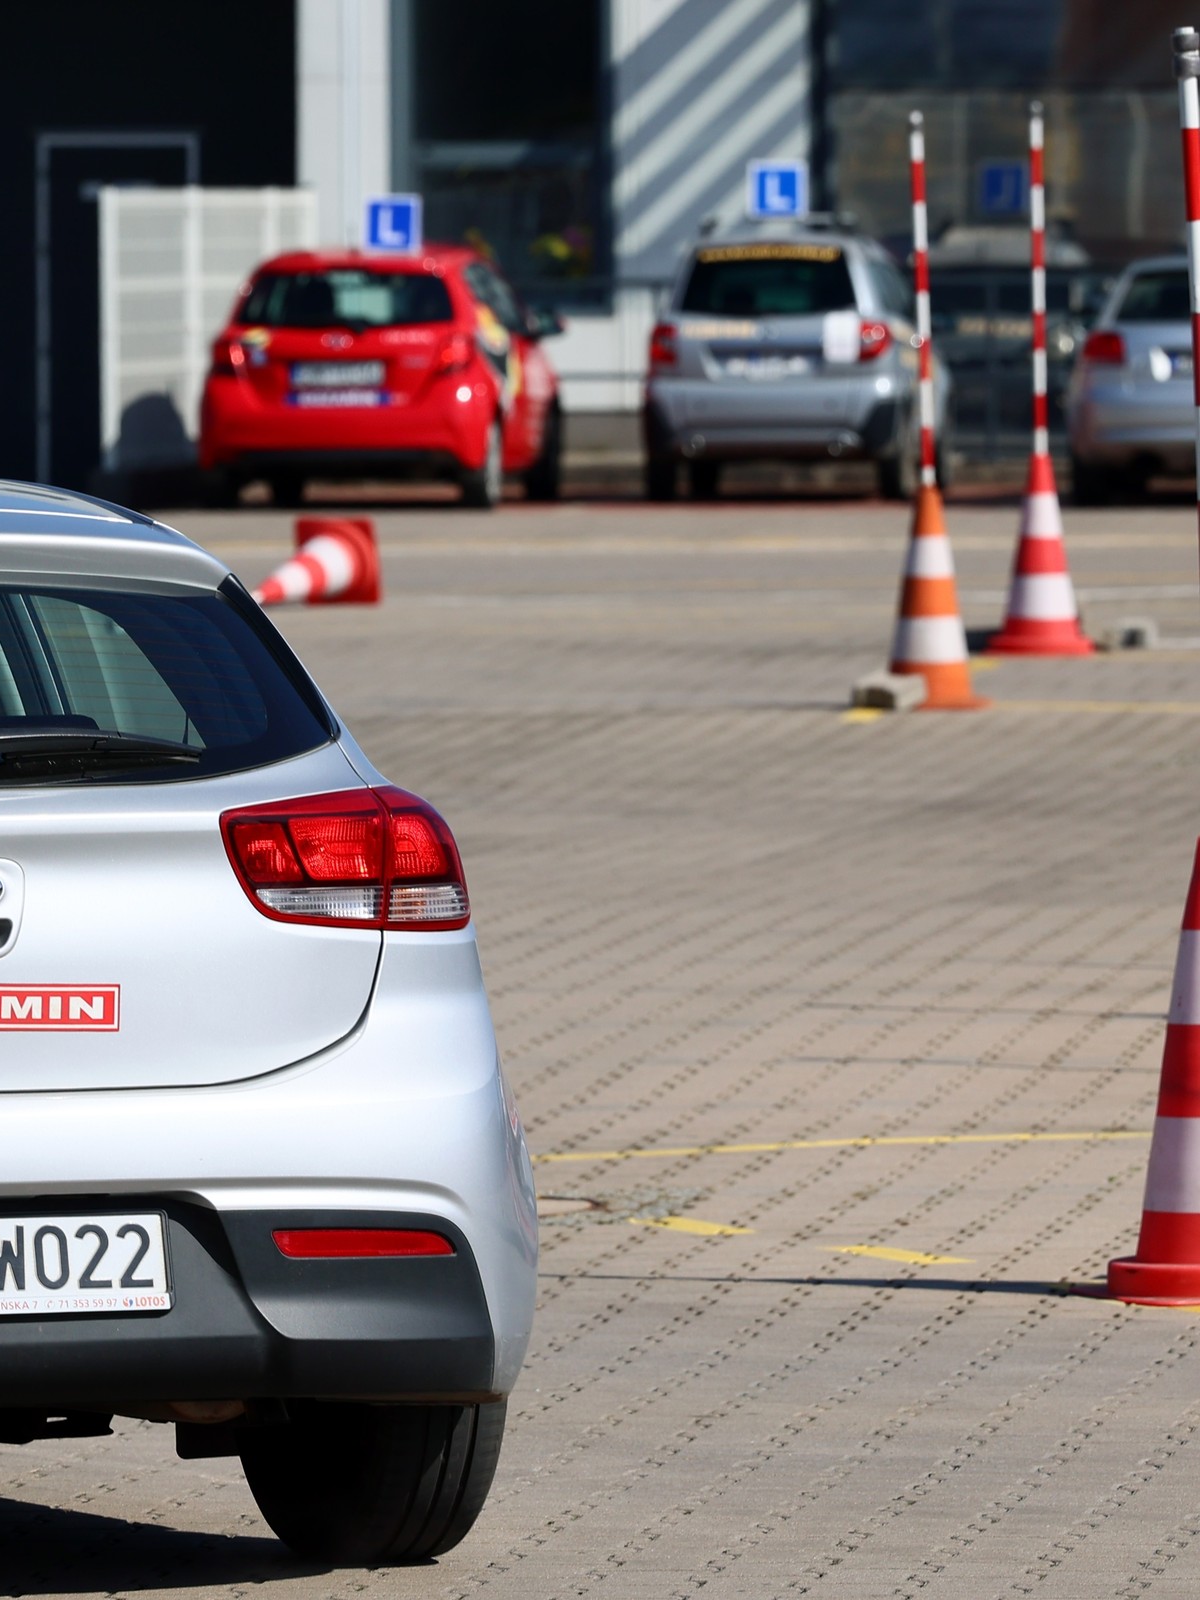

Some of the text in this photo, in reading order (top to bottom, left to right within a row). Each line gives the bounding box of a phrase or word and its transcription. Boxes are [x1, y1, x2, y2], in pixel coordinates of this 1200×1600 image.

[764, 173, 793, 212] L
[377, 206, 407, 246] L
[33, 1300, 39, 1309] 7
[59, 1300, 69, 1309] 71
[73, 1299, 90, 1308] 353
[92, 1299, 104, 1308] 59
[135, 1296, 166, 1307] LOTOS
